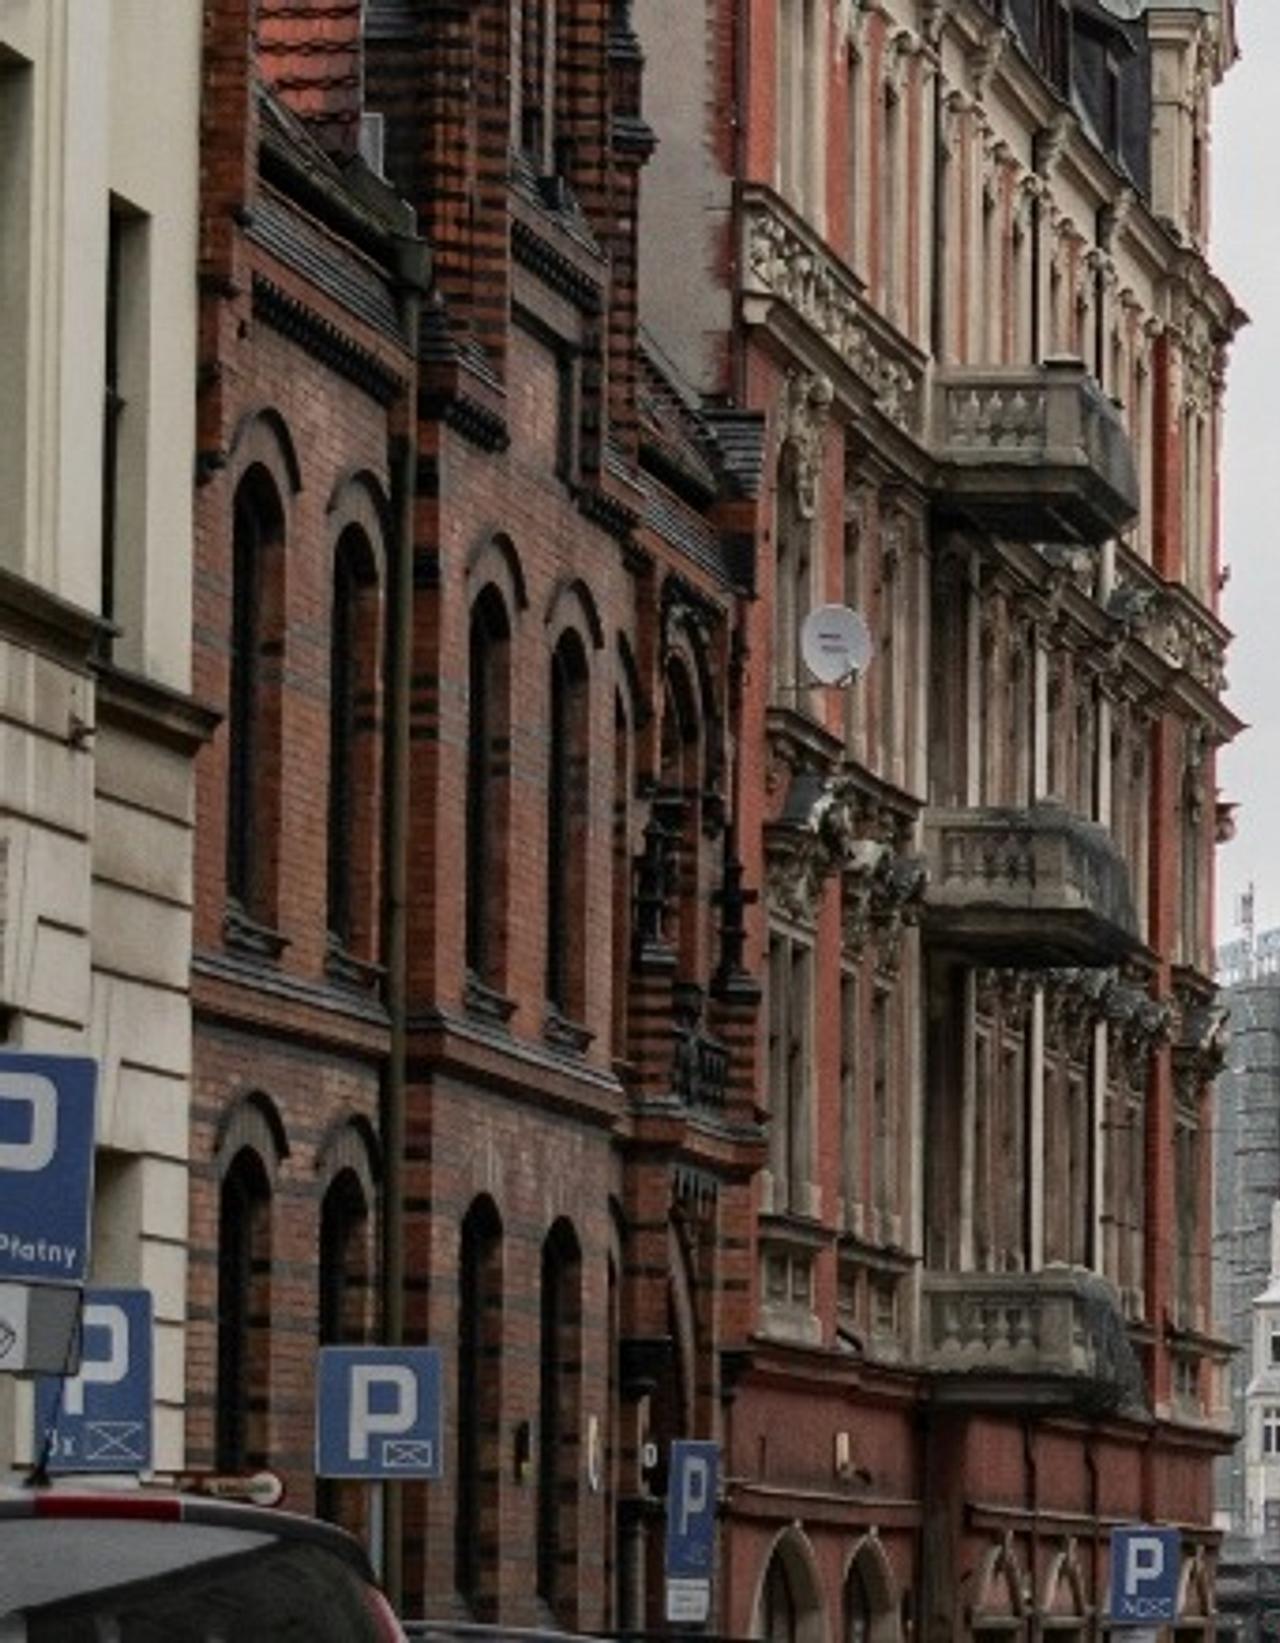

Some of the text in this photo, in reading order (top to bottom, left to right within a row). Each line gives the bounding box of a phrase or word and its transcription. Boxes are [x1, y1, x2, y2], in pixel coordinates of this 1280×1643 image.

[64, 1305, 129, 1415] P
[348, 1365, 418, 1460] P
[679, 1454, 706, 1535] P
[1124, 1537, 1165, 1595] P
